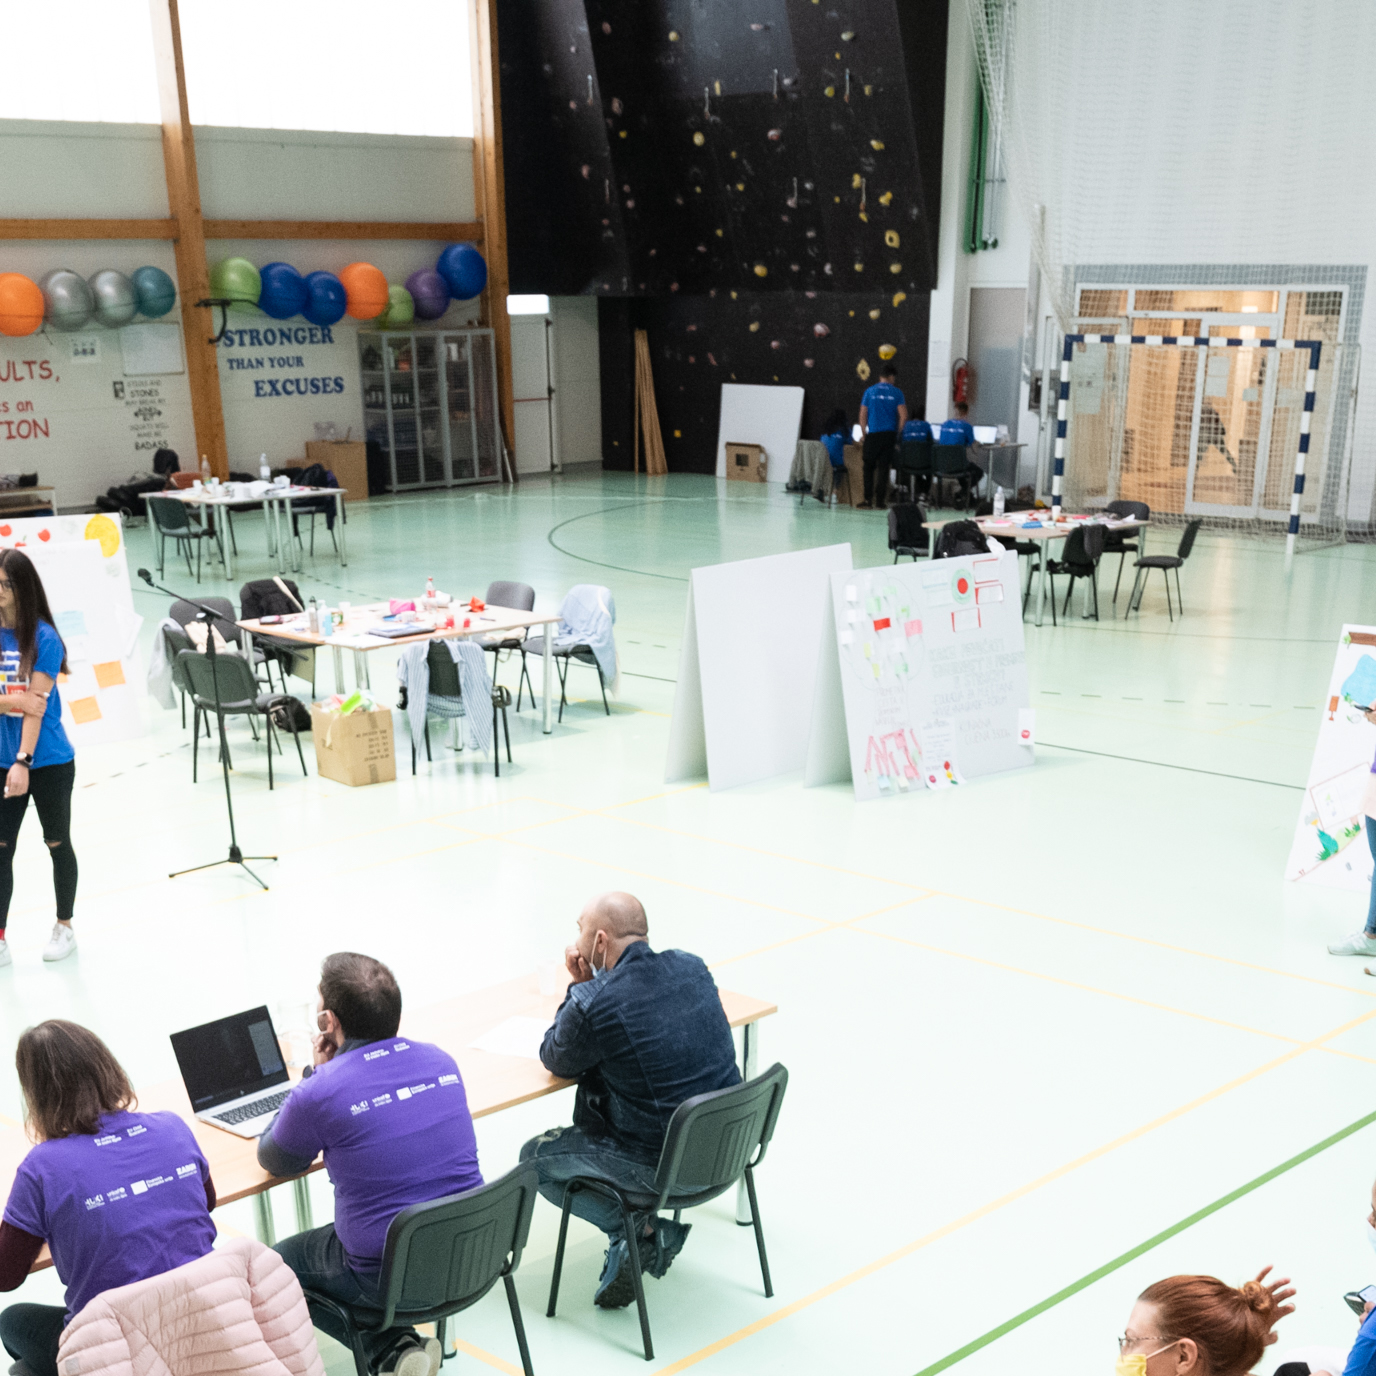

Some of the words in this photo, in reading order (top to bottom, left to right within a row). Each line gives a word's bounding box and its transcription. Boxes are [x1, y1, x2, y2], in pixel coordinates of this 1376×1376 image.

[223, 326, 334, 347] STRONGER
[226, 357, 264, 370] THAN
[268, 355, 304, 368] YOUR
[130, 389, 159, 398] STONES
[254, 376, 345, 397] EXCUSES
[16, 400, 34, 413] an
[135, 440, 169, 450] BADASS
